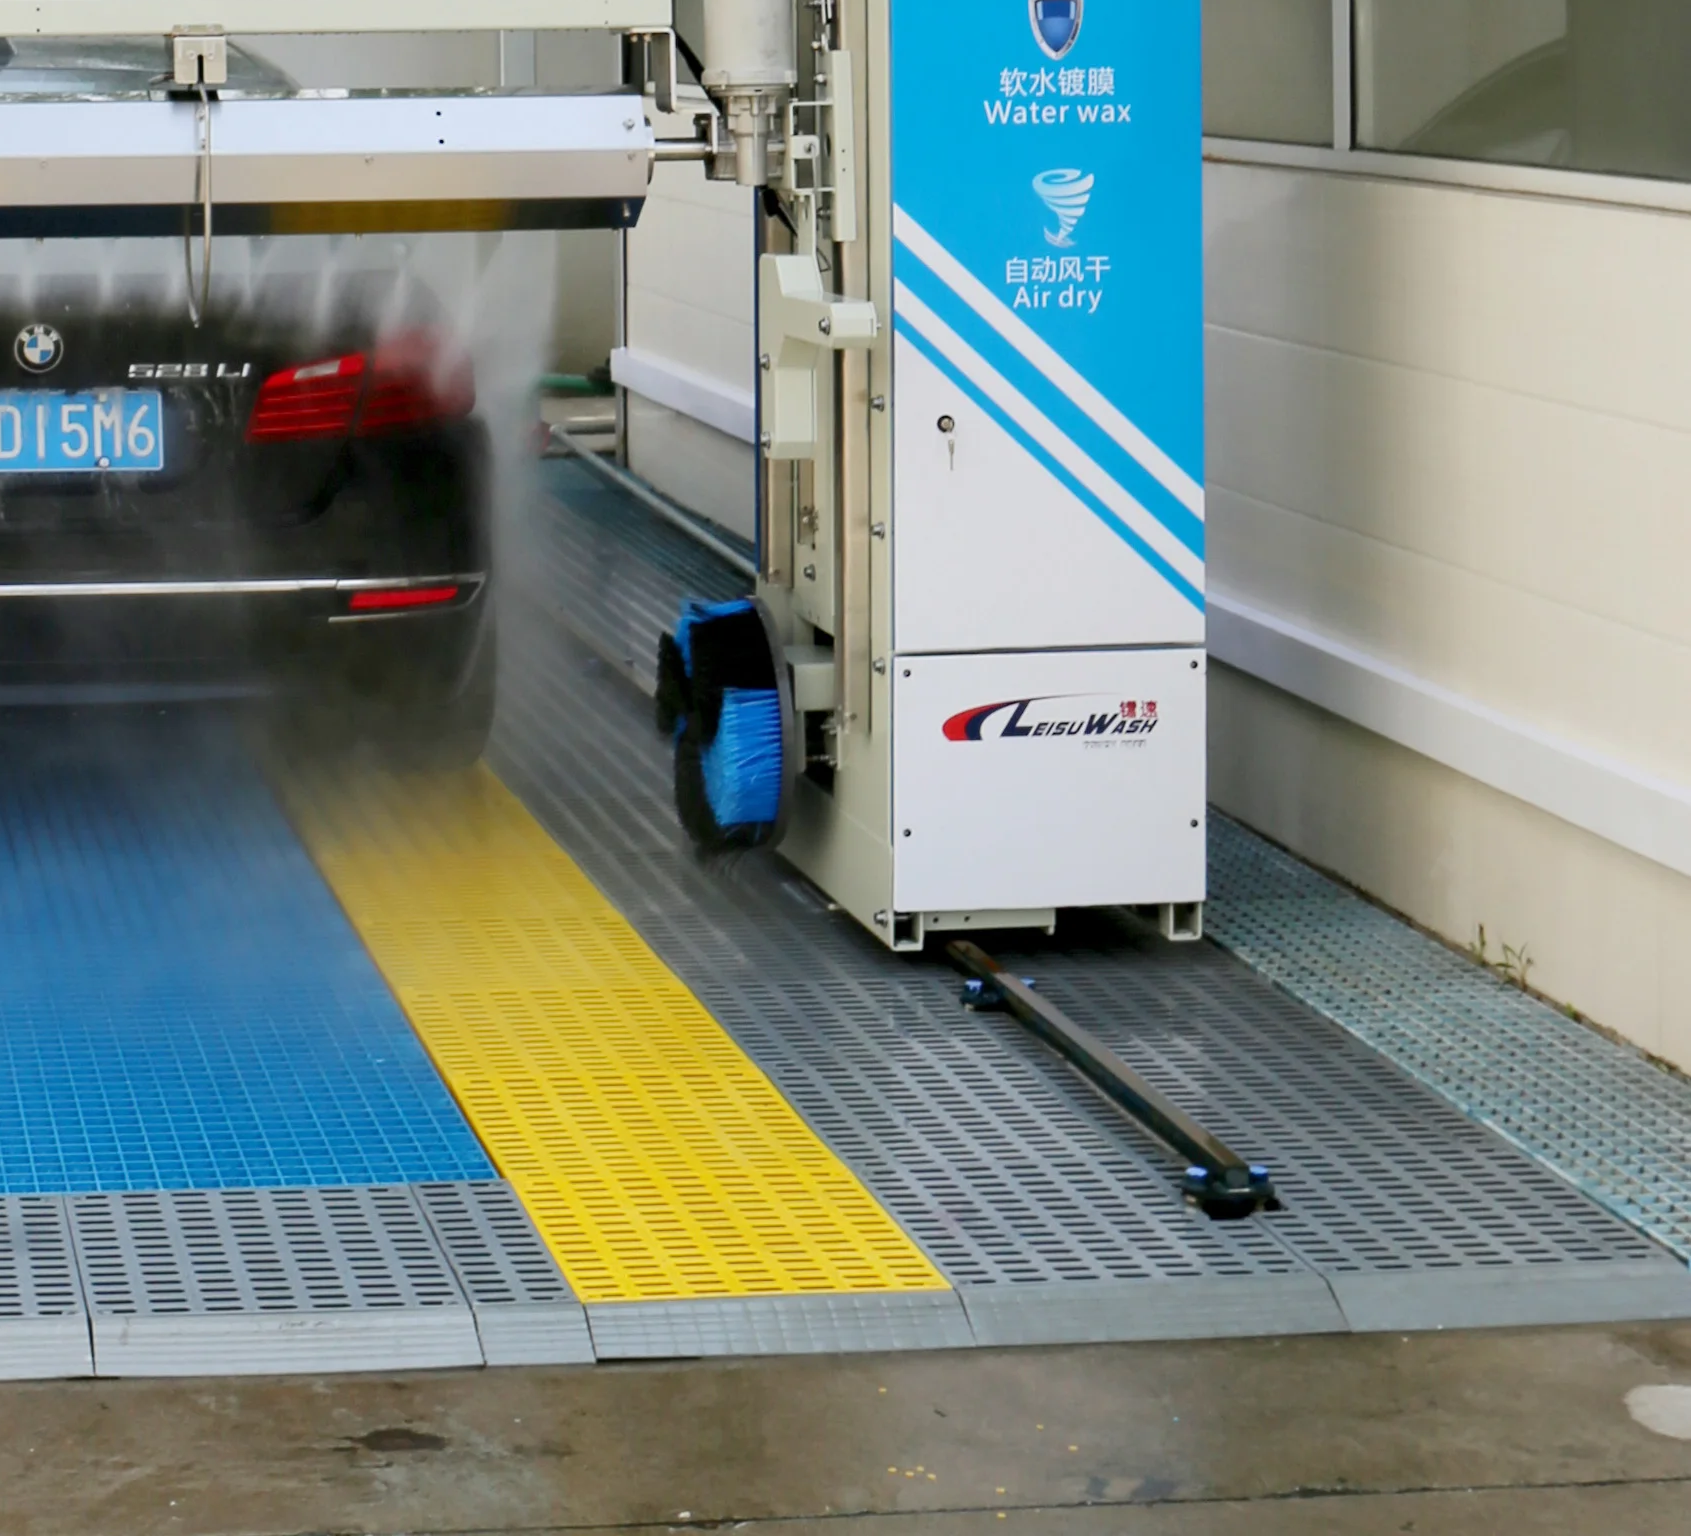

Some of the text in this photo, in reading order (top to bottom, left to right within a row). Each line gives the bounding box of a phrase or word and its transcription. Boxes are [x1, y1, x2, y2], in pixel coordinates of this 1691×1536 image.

[999, 66, 1116, 97] 软水镀膜
[983, 100, 1132, 125] Water wax
[1006, 255, 1111, 284] 自动风干
[1012, 284, 1103, 314] Air dry
